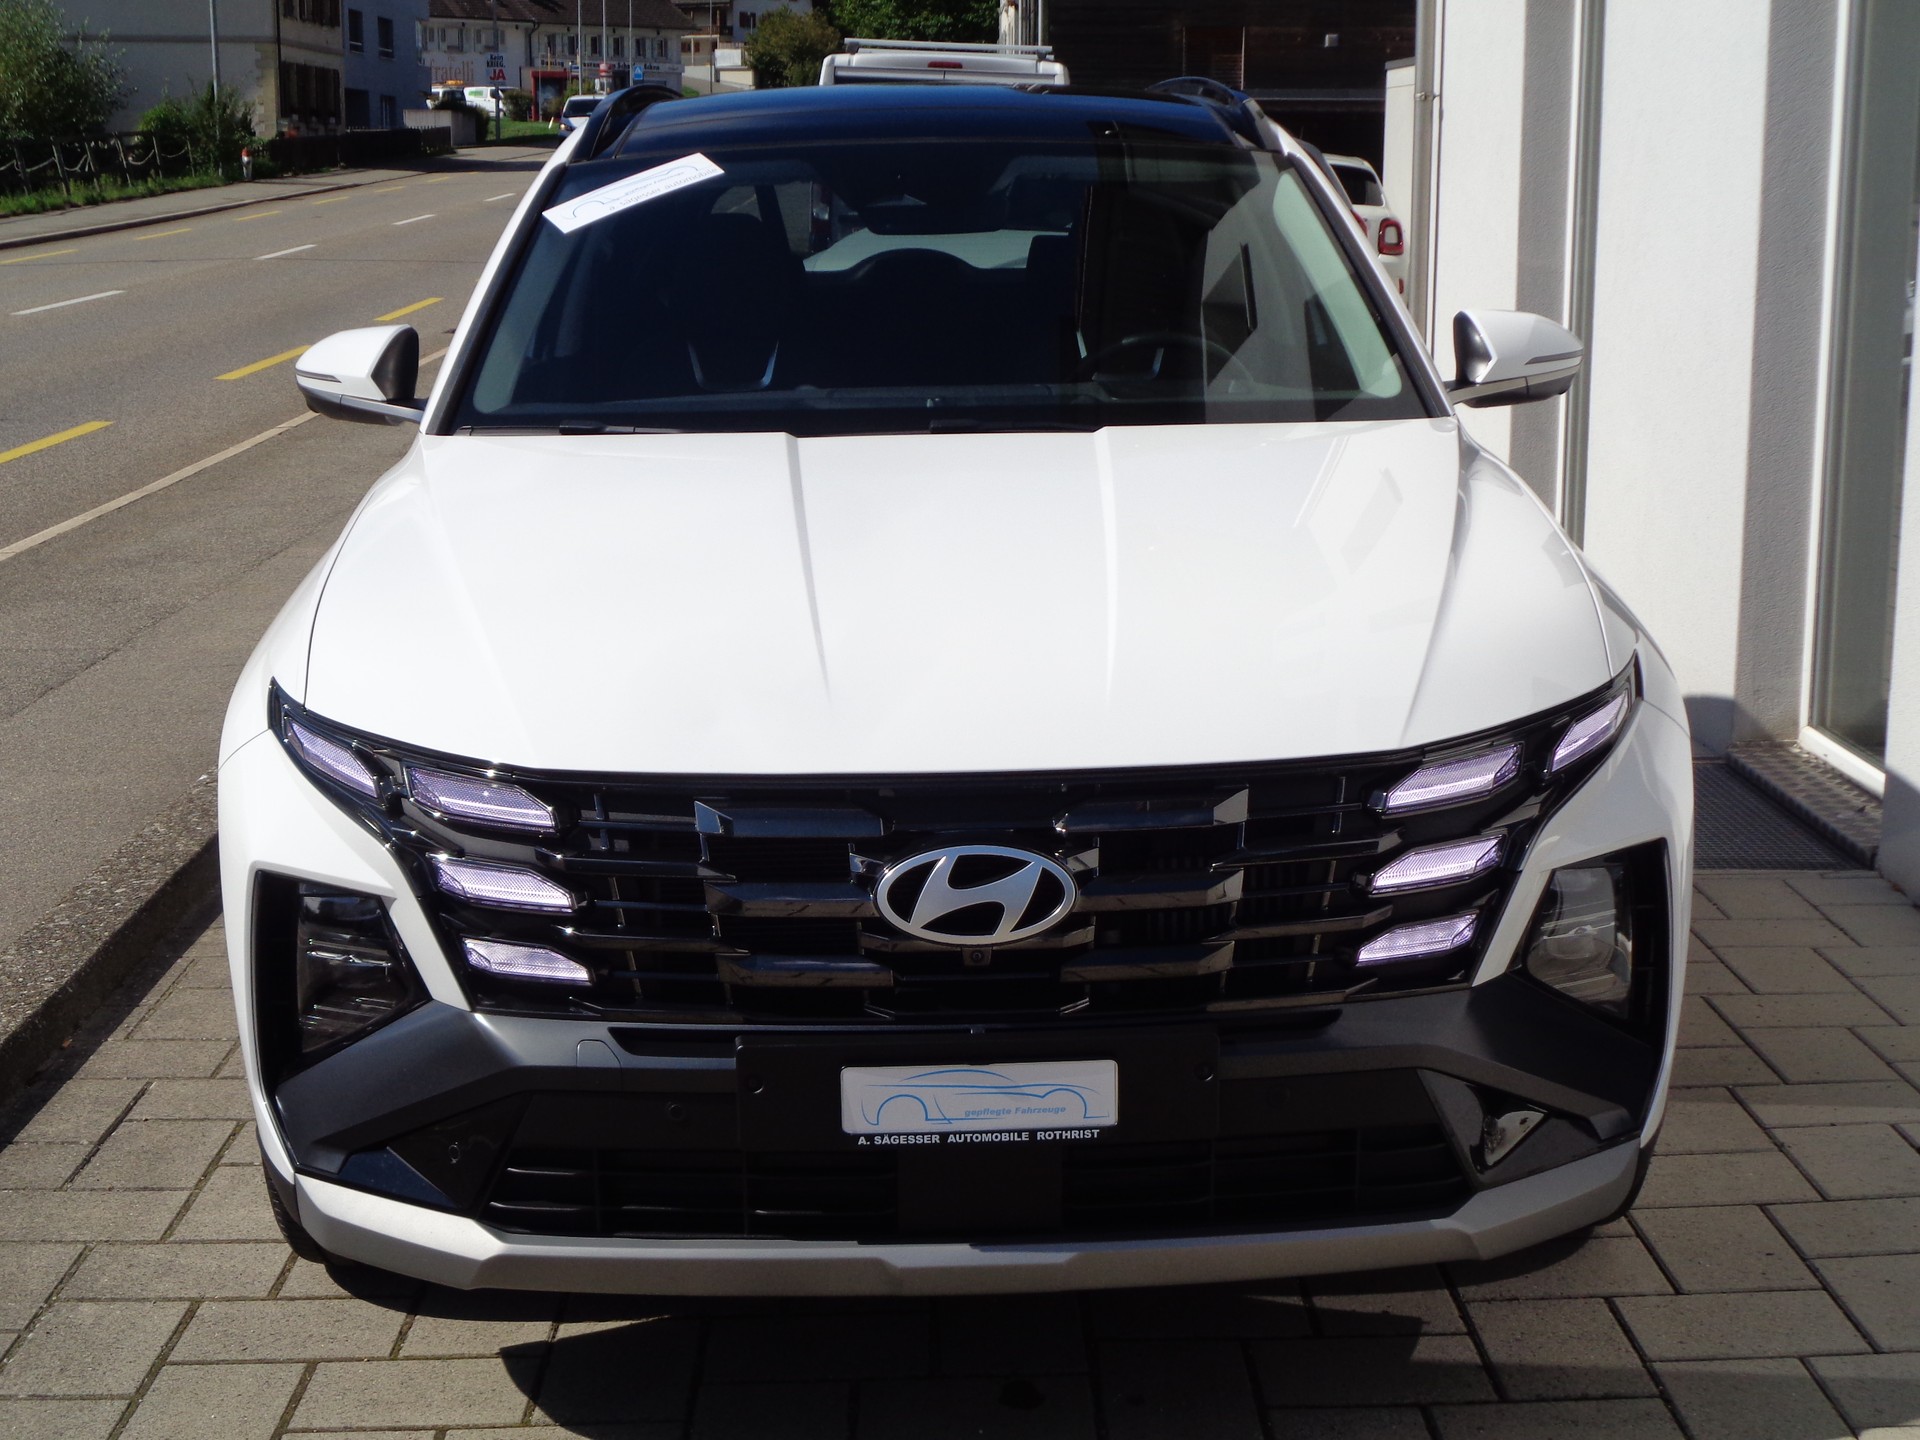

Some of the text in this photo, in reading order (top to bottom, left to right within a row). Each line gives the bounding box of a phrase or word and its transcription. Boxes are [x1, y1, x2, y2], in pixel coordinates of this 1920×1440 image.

[489, 68, 507, 81] JA
[964, 1105, 1066, 1118] gepflegte Fahrzeuge
[857, 1128, 1100, 1146] A. SÄGESSER AUTOMOBILE ROTHRIST
